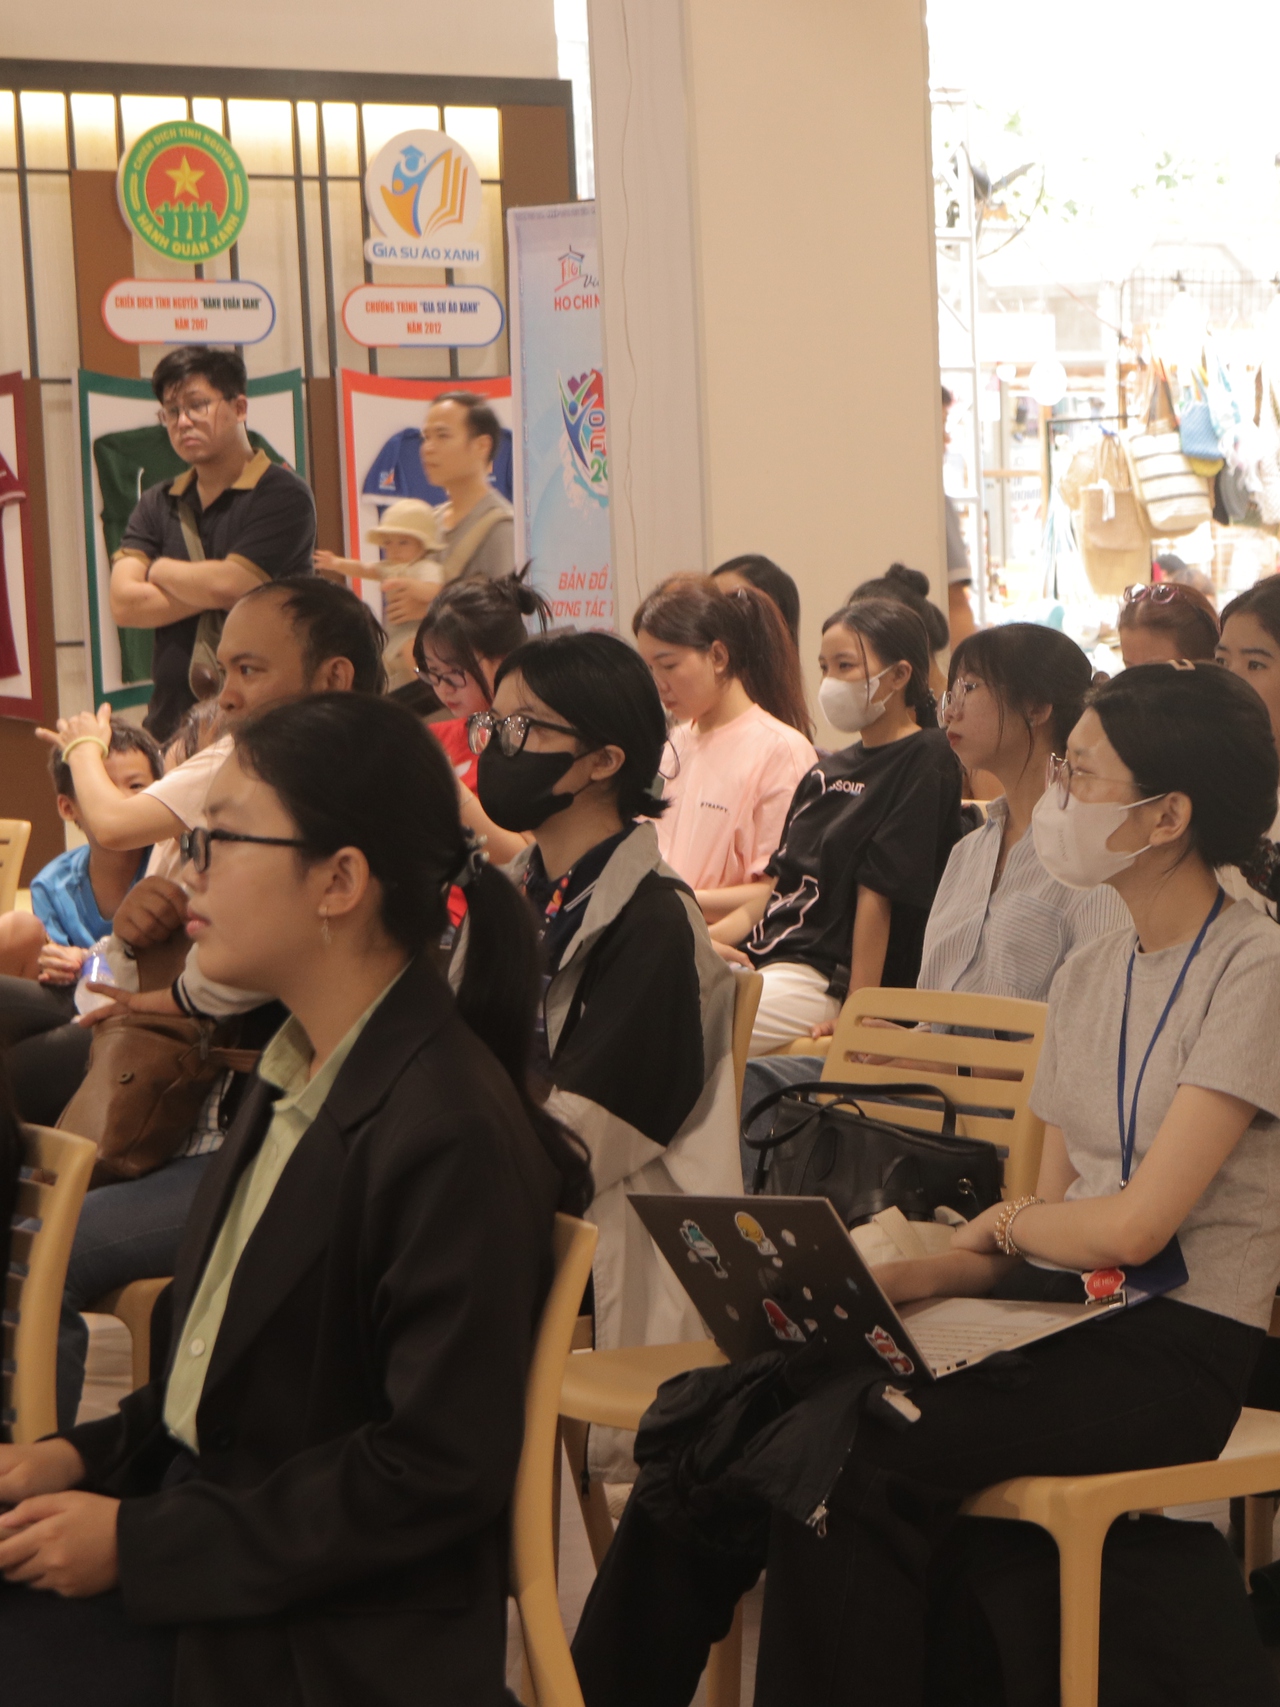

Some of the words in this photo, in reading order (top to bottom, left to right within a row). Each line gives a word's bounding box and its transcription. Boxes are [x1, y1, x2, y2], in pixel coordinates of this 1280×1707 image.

[444, 248, 480, 262] XANH
[554, 295, 571, 311] HO
[573, 294, 593, 310] CHI
[558, 565, 586, 590] BẢN
[588, 563, 609, 590] ĐỒ
[585, 596, 607, 617] TÁC
